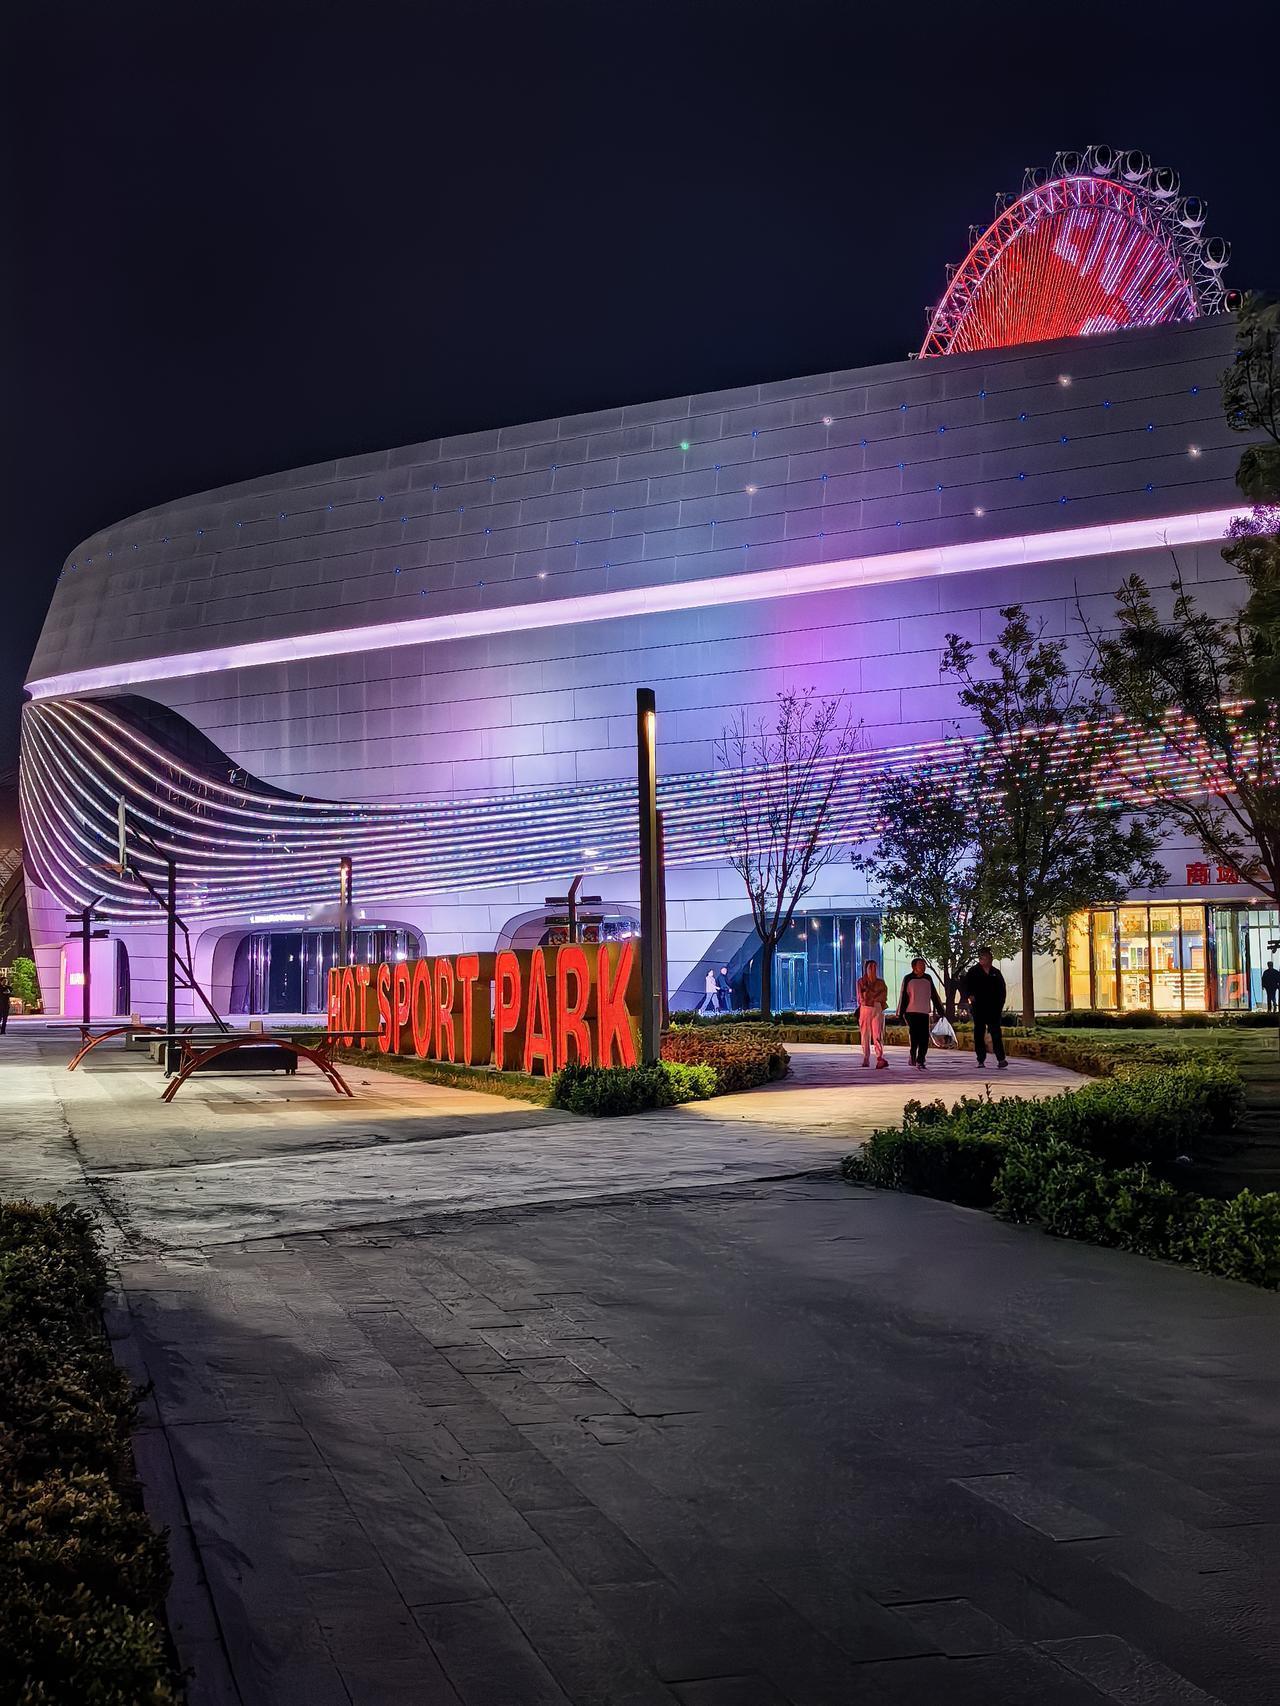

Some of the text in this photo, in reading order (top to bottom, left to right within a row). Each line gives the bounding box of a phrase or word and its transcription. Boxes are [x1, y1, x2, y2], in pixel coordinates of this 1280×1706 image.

[328, 941, 638, 1077] HOT SPORT PARK
